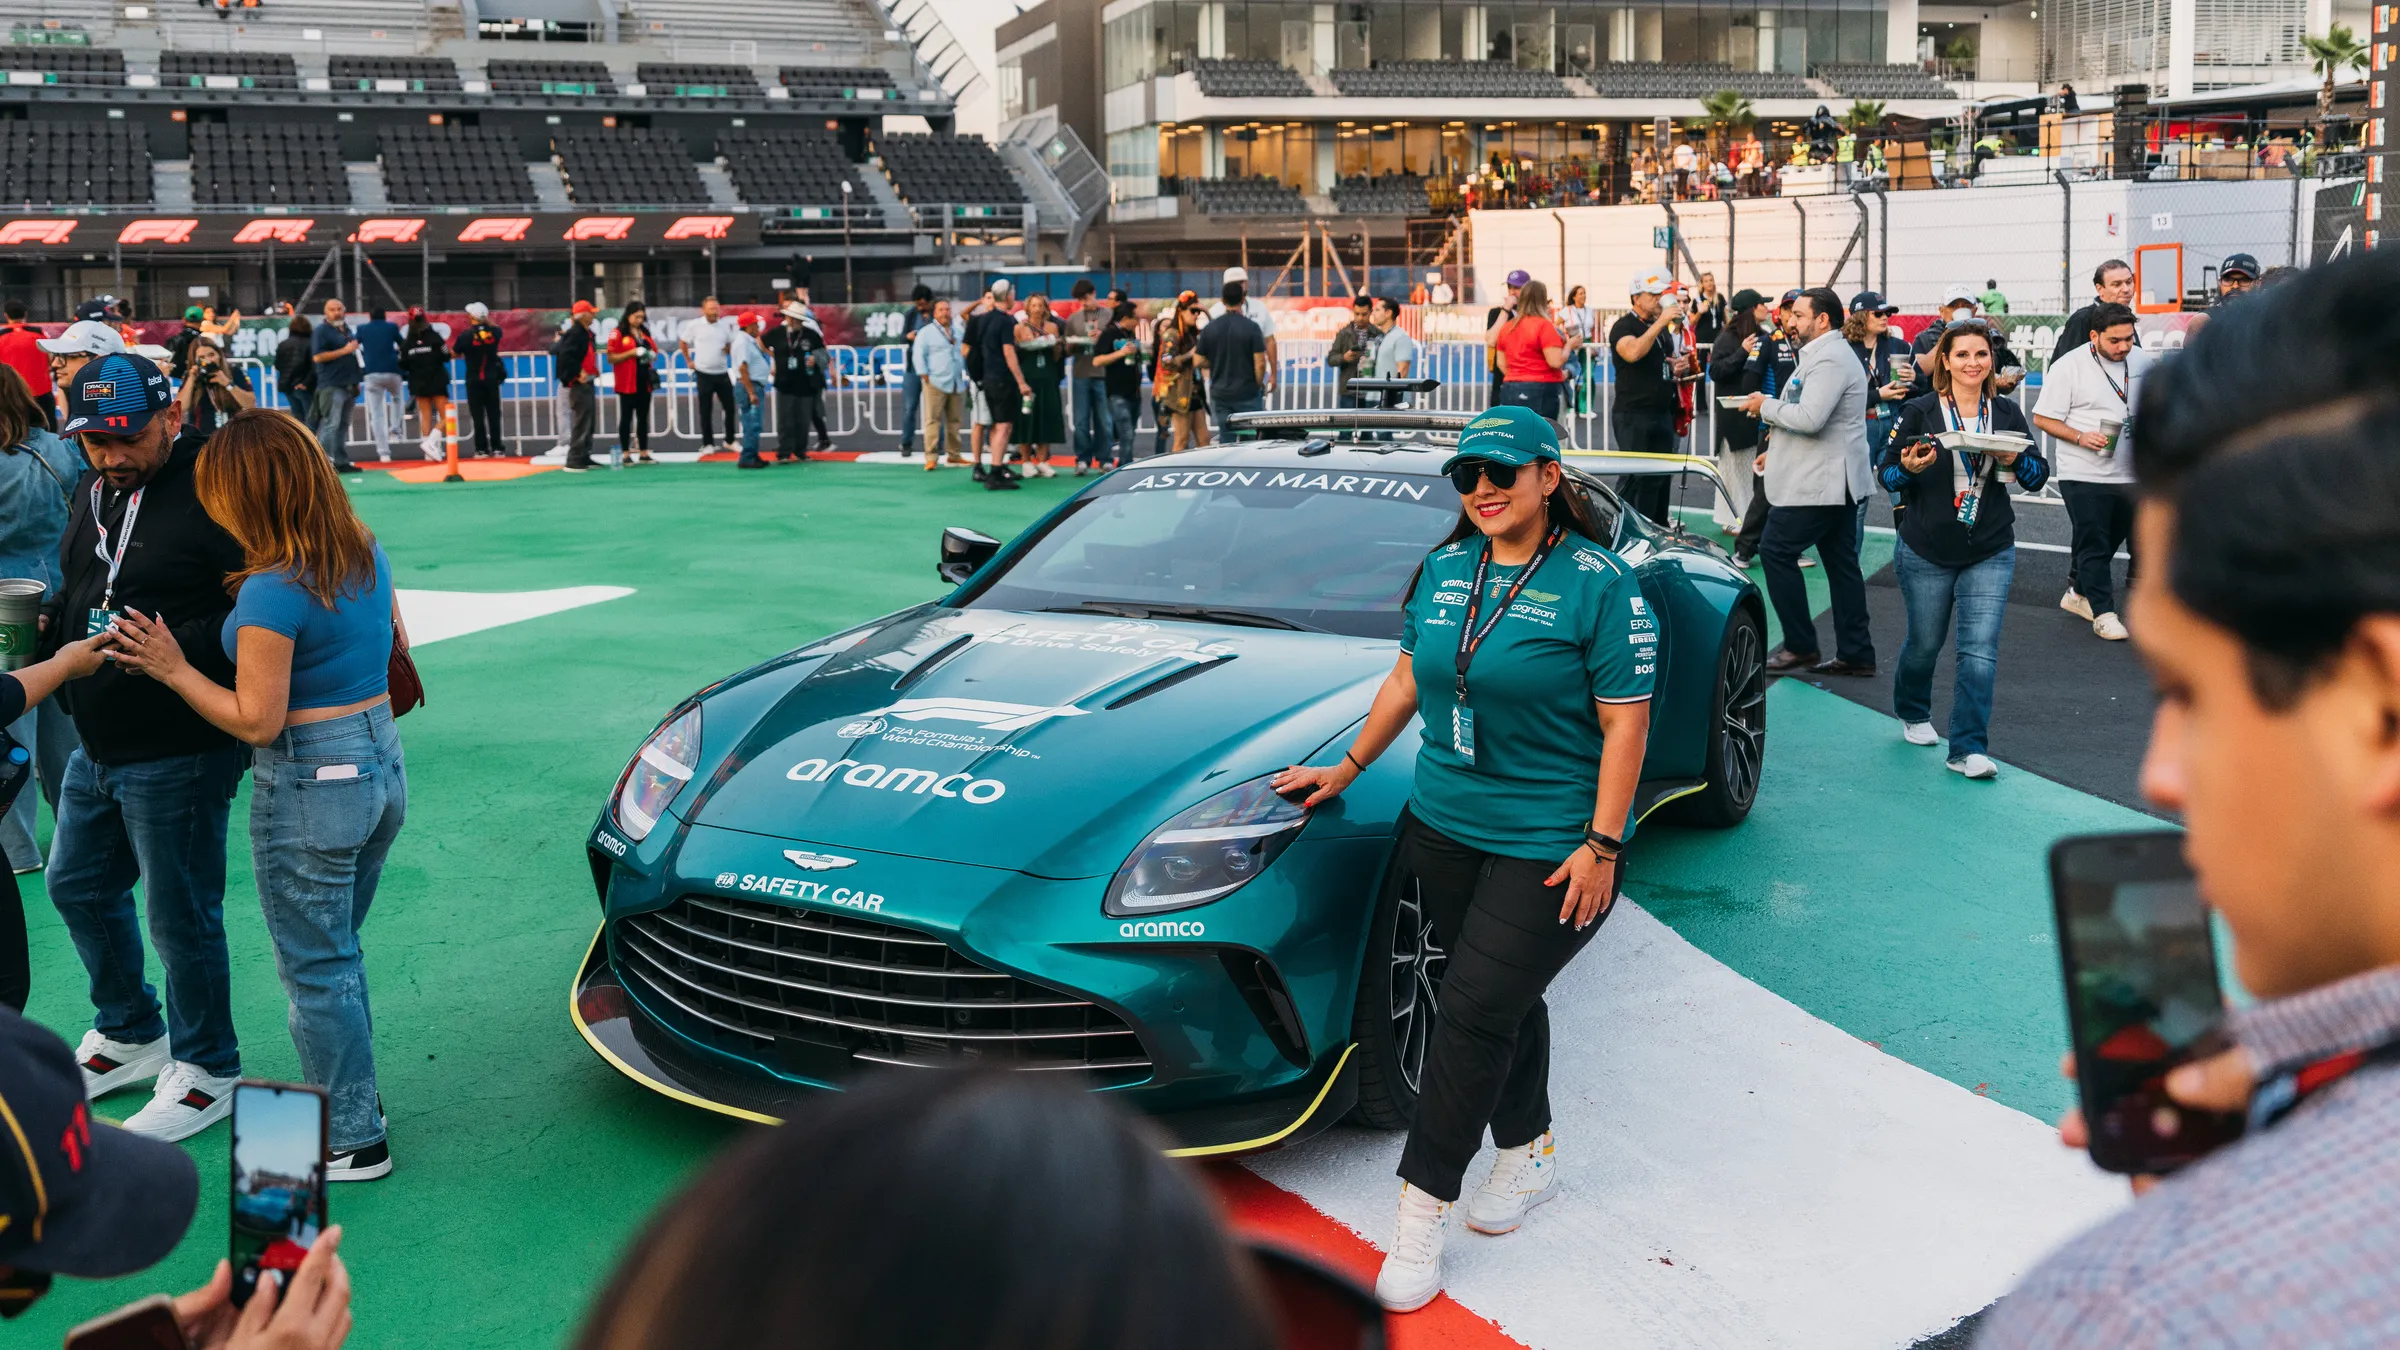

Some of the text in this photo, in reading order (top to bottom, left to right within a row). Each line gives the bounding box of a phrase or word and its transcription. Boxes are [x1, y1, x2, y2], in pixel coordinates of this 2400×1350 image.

[2156, 216, 2168, 227] 13
[104, 415, 128, 427] 11
[1497, 431, 1515, 440] TEAM
[1128, 471, 1430, 501] ASTON MARTIN
[1573, 549, 1606, 572] PERONI
[1516, 554, 1543, 586] Experiences
[1441, 579, 1473, 590] aramco
[1434, 592, 1467, 606] JCB
[1511, 604, 1557, 620] cognizant
[1477, 607, 1504, 638] Experiences
[1540, 619, 1553, 627] TEAM
[1630, 619, 1653, 630] EPOS
[982, 628, 1235, 657] SAFETY CAR
[1461, 618, 1474, 653] Experiences
[1010, 636, 1159, 658] Drive Safely
[881, 732, 931, 747] World
[888, 726, 916, 736] FIA
[914, 728, 974, 743] Formula
[785, 758, 1006, 805] aramco
[597, 830, 627, 857] aramco
[739, 873, 885, 913] SAFETY CAR
[1119, 921, 1205, 938] aramco
